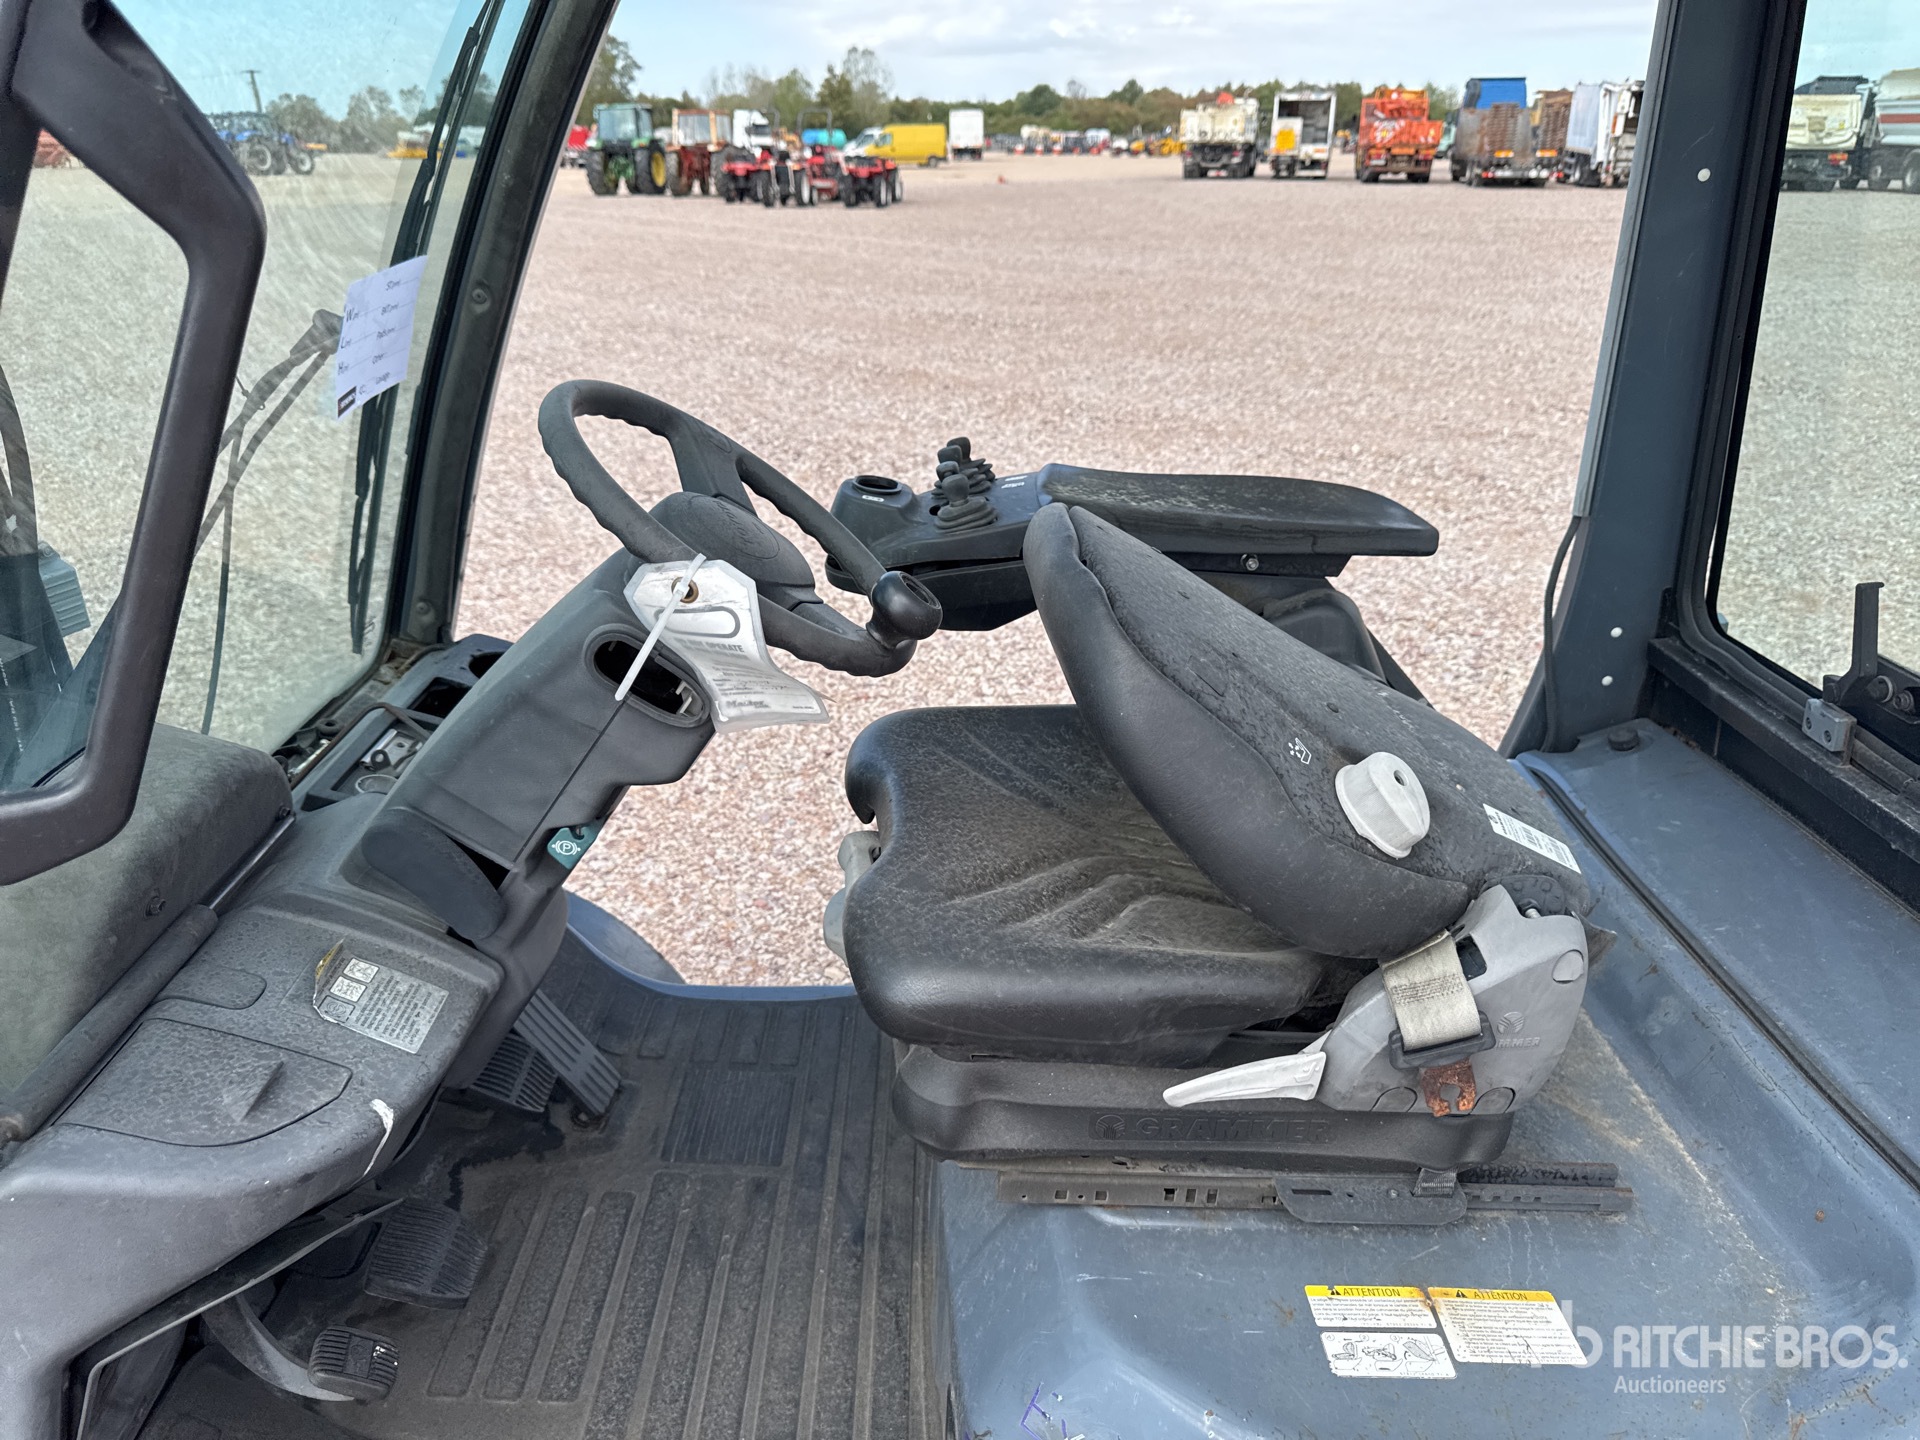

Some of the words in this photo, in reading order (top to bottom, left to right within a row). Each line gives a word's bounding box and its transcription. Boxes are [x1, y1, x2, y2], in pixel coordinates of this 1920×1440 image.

[1135, 1117, 1329, 1142] GRAMMER
[1342, 1287, 1401, 1297] ATTENTION
[1473, 1291, 1529, 1301] ATTENTION
